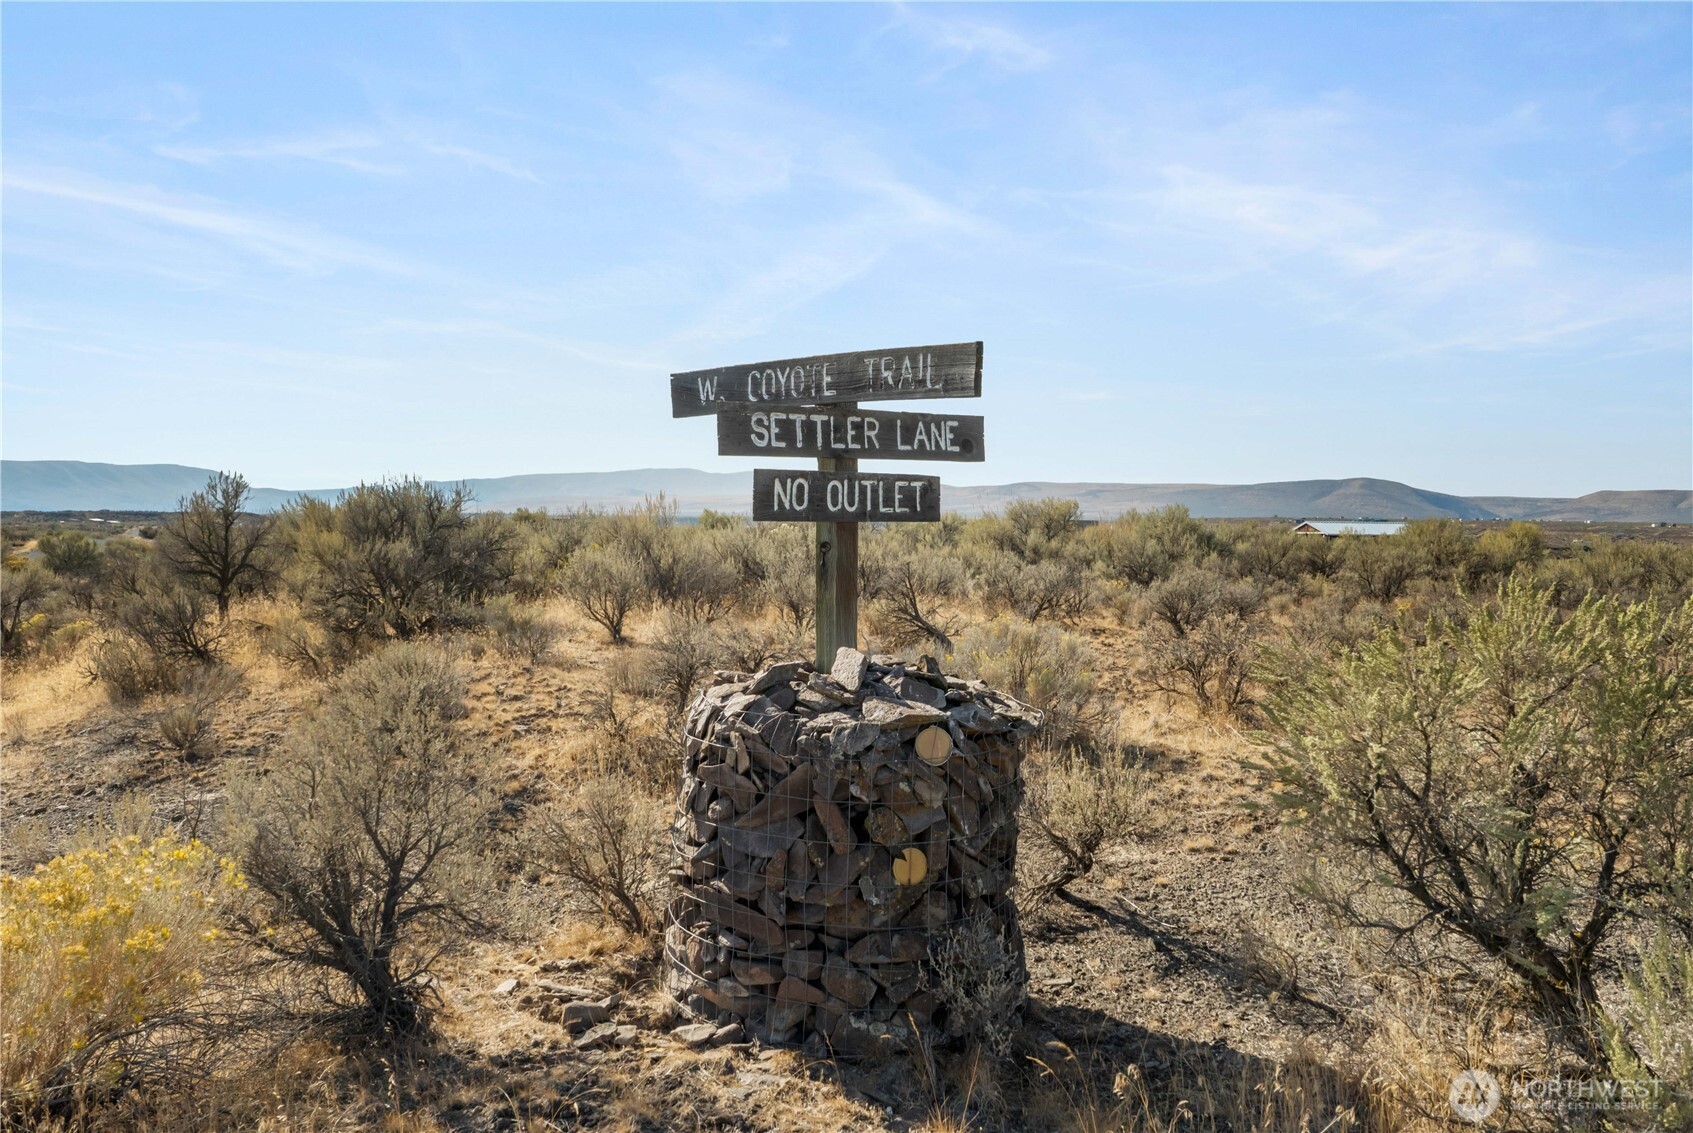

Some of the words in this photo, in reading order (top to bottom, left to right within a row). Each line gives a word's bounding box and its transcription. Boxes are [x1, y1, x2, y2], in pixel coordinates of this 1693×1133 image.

[748, 363, 836, 402] COYOTE
[864, 353, 942, 392] TRAIL
[751, 412, 880, 449] SETTLER
[897, 419, 960, 452] LANE
[773, 478, 809, 511] NO
[827, 479, 926, 513] OUTLET
